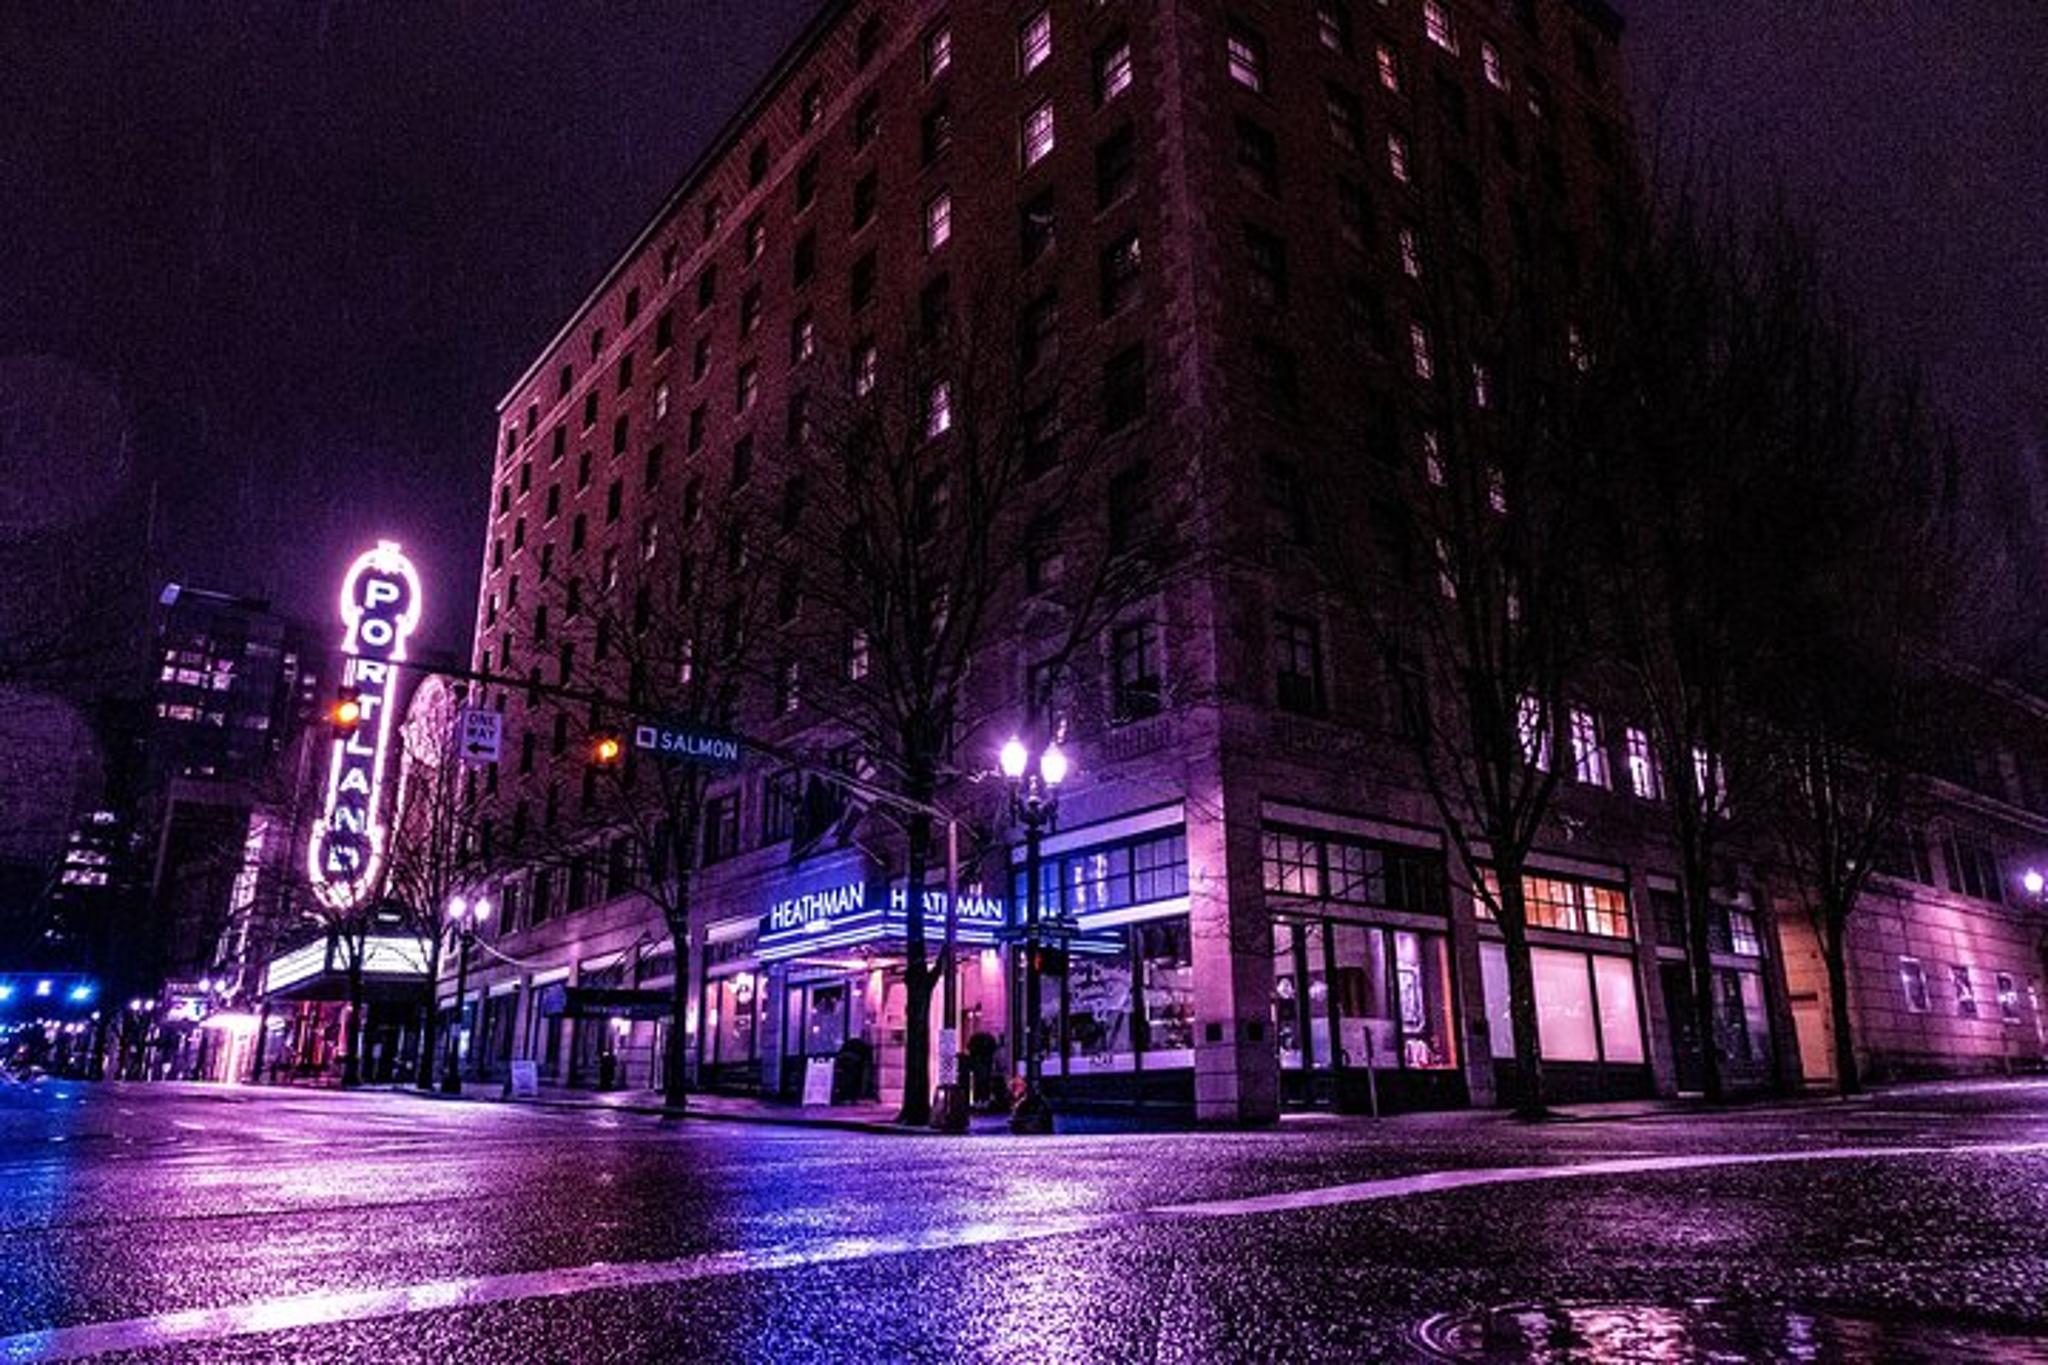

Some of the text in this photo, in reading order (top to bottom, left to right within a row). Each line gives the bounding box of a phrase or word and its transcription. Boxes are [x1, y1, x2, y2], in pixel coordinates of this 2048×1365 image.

[326, 579, 400, 871] PORTLAND
[467, 727, 497, 739] WAY
[469, 713, 495, 727] ONE
[661, 732, 738, 760] SALMON
[772, 881, 865, 929] HEATHMAN
[891, 888, 1003, 918] HATMAN
